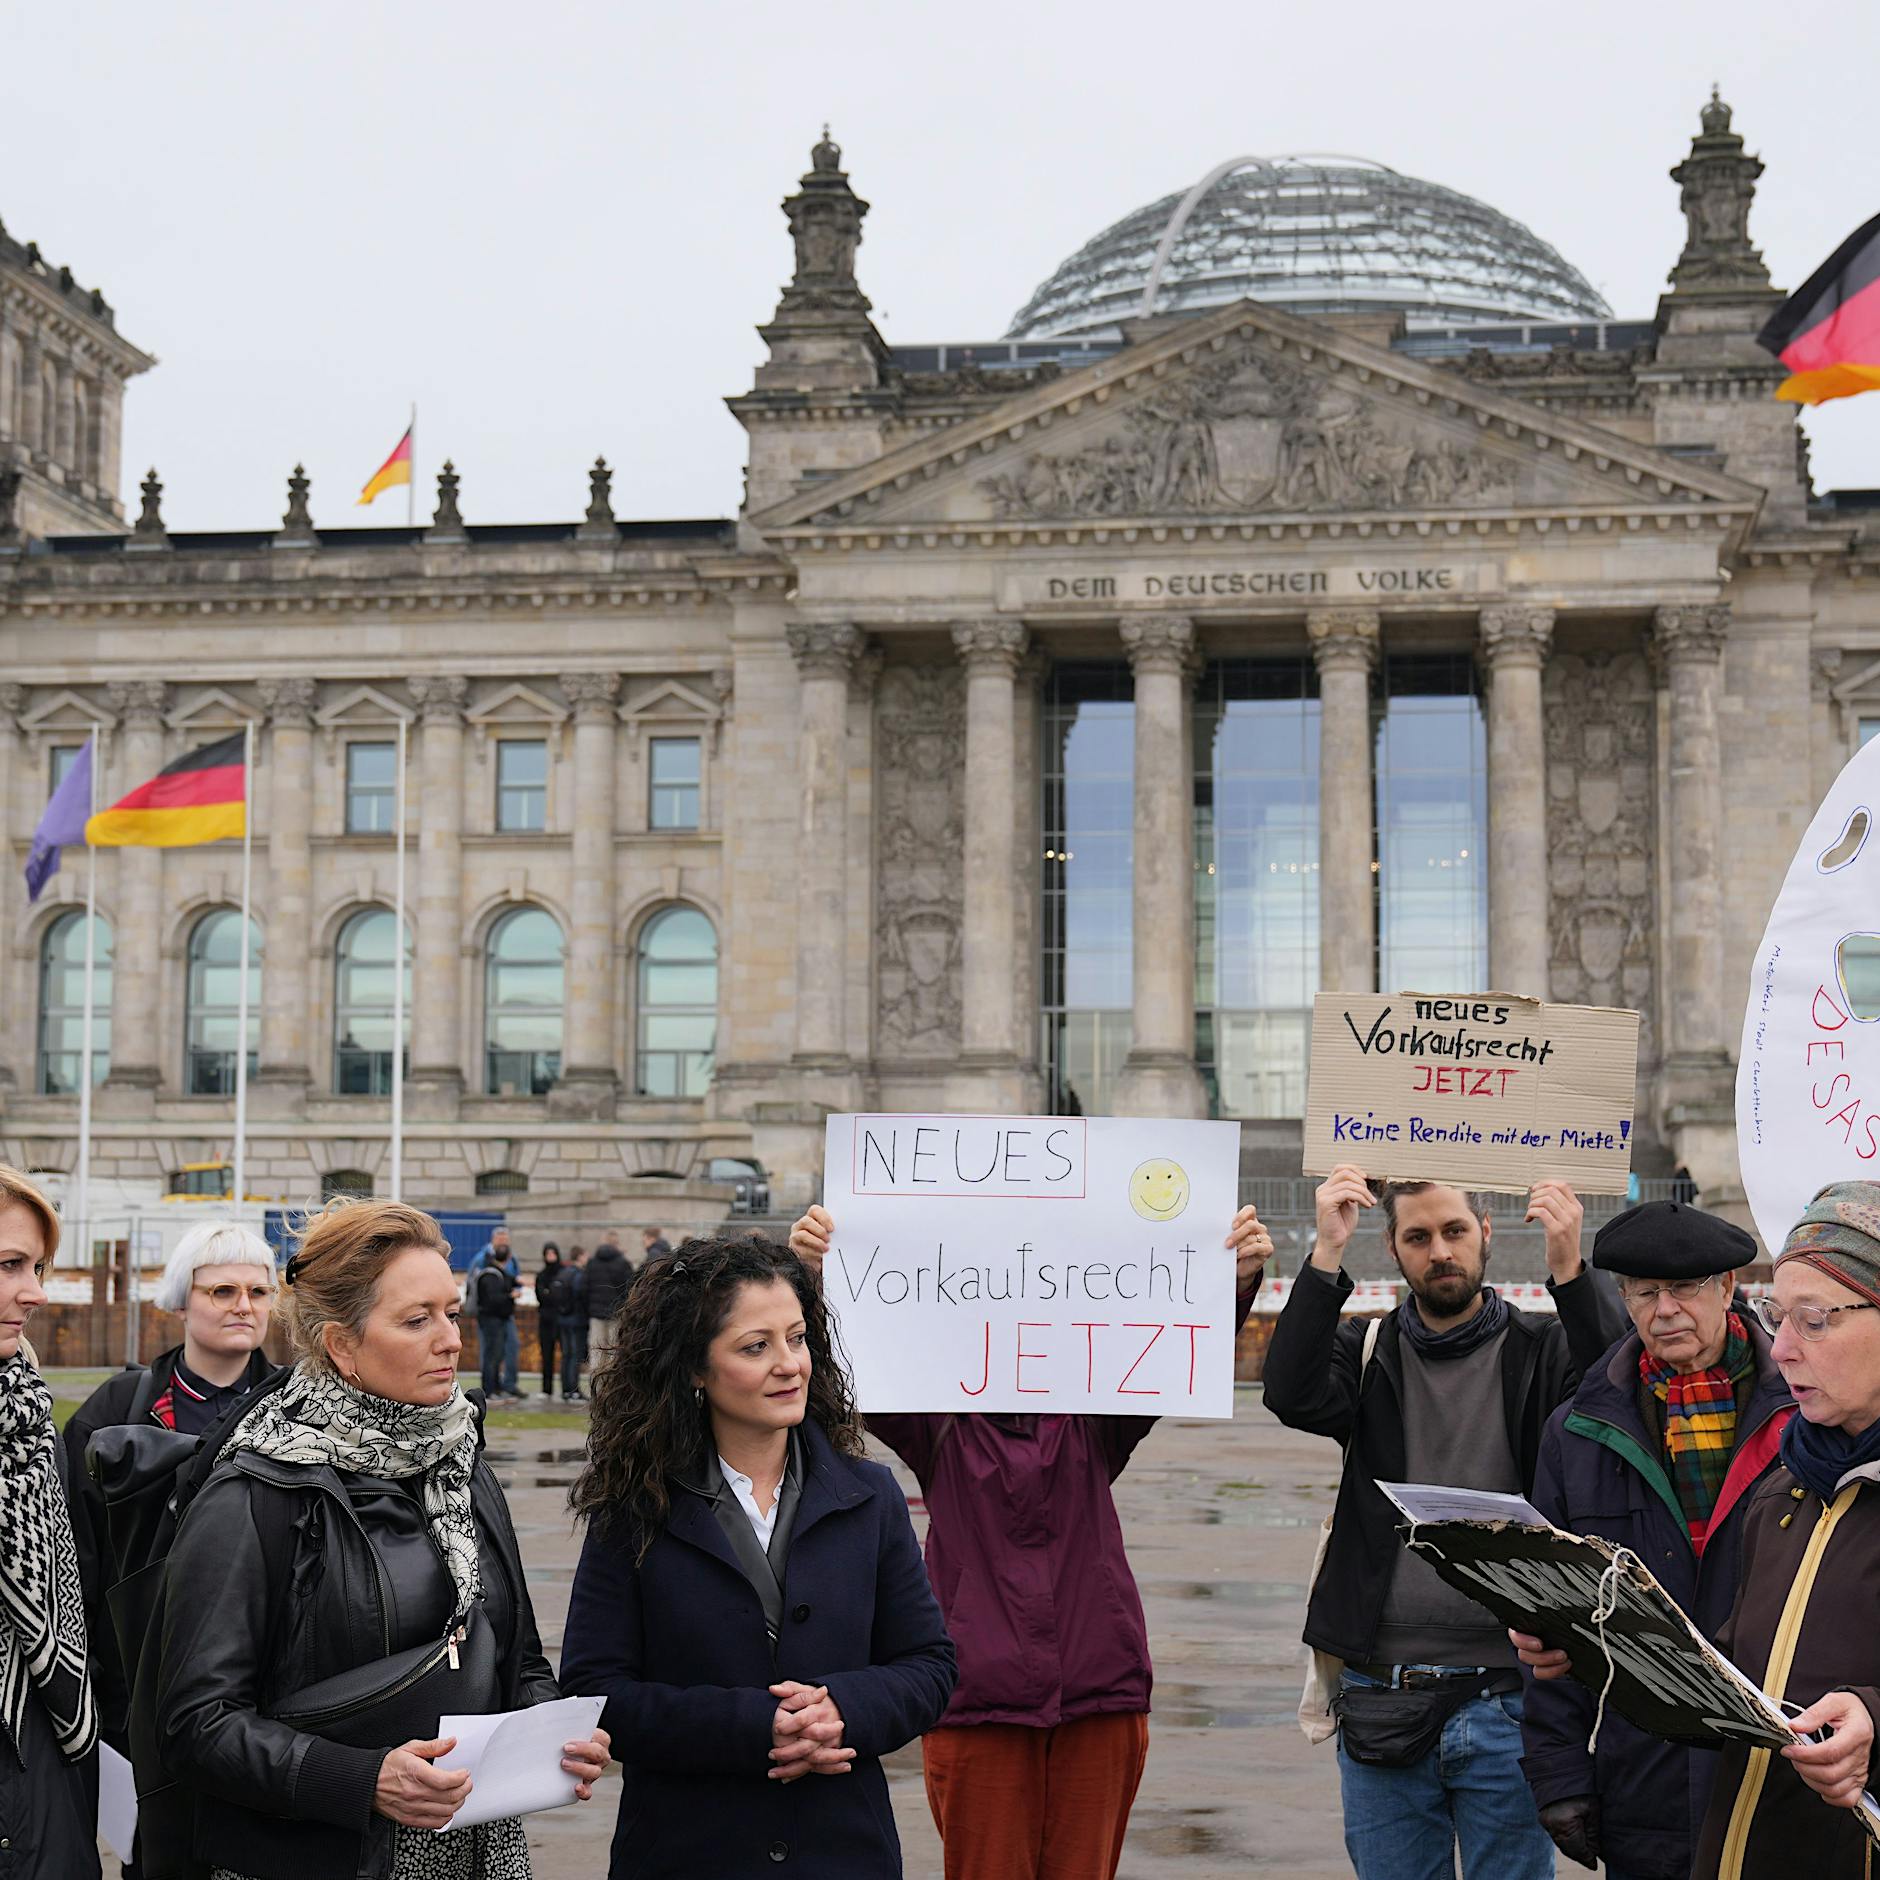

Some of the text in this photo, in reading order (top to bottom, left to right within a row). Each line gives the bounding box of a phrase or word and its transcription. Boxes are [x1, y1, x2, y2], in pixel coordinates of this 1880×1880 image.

[1049, 568, 1454, 599] DEM DEUTSCHEN VOLKE
[1415, 999, 1509, 1024] neues
[1344, 1006, 1553, 1065] Vorkaufsrecht
[1413, 1065, 1519, 1098] JETZT
[1333, 1112, 1400, 1143] Keine
[1410, 1117, 1482, 1144] Rendite
[1491, 1126, 1517, 1145] mit
[1520, 1132, 1550, 1147] der
[862, 1128, 1072, 1186] NEUES
[838, 1242, 1196, 1305] Vorkaufsrecht
[960, 1321, 1210, 1395] JETZT
